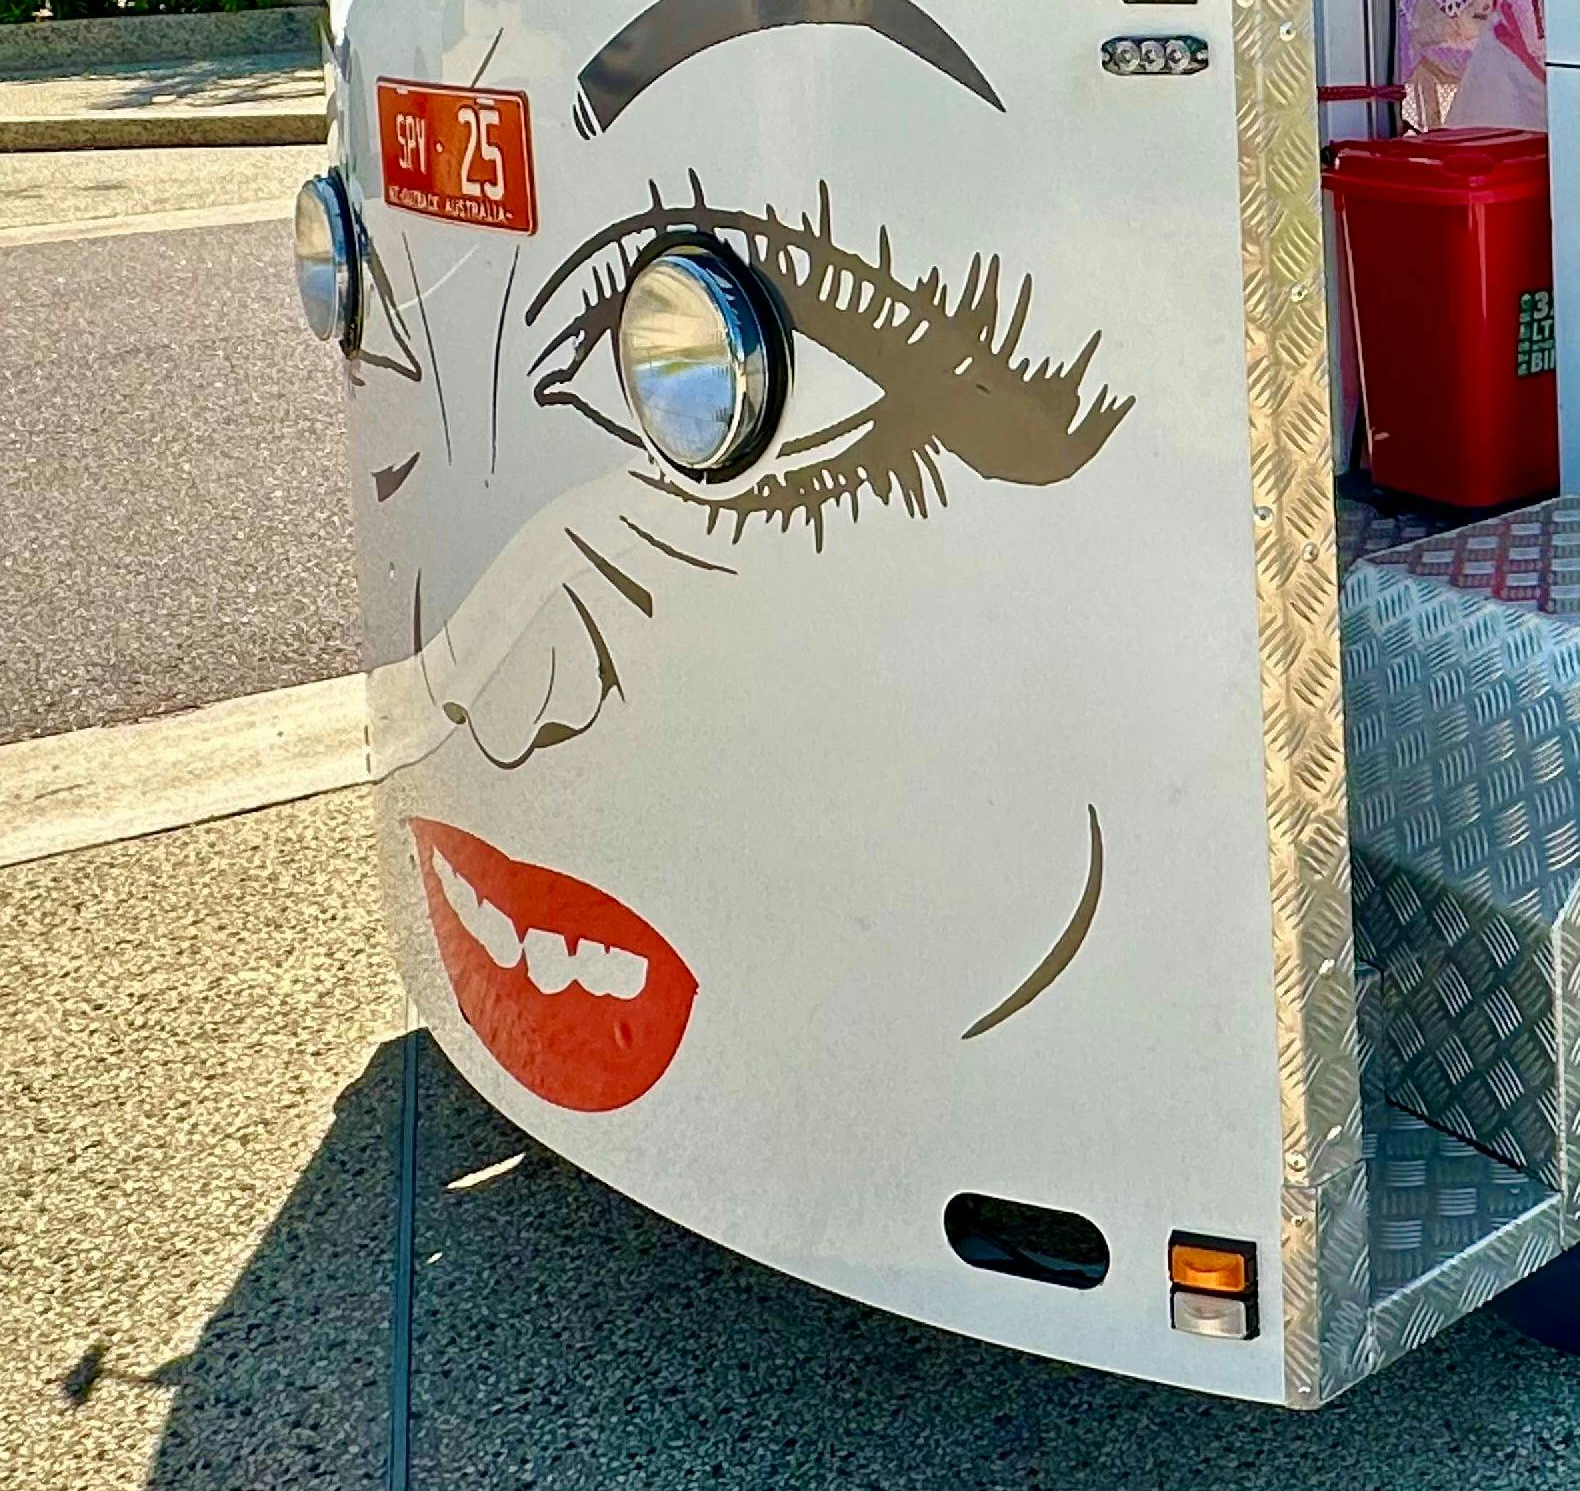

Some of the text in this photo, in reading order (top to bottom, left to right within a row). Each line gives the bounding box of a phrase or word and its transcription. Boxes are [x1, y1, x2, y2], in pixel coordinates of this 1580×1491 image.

[396, 105, 505, 202] SPY 25
[445, 197, 506, 224] AUSTRALIA
